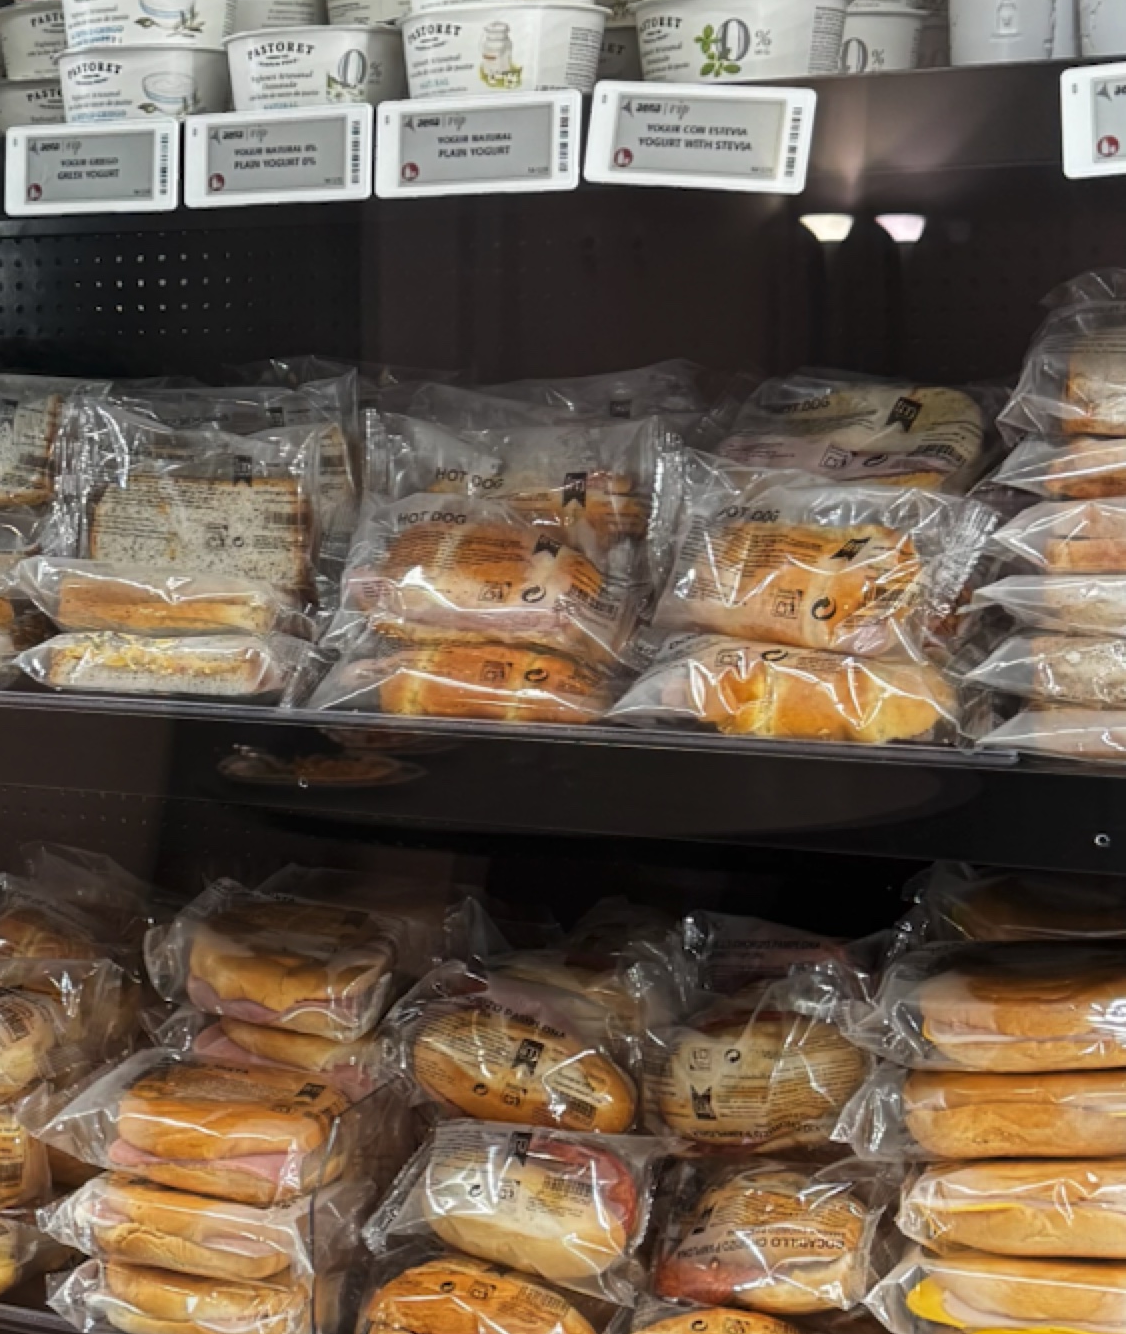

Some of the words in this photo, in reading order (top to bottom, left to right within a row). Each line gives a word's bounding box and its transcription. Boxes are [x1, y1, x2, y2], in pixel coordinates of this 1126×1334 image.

[247, 41, 316, 61] PASTORET
[437, 148, 468, 159] PLAIN
[470, 144, 511, 157] YOGURT
[638, 136, 682, 148] YOGURT
[684, 138, 713, 150] WITH
[715, 140, 753, 152] STEVIA
[435, 468, 468, 482] HOT
[471, 474, 504, 490] DOG
[397, 512, 428, 525] HOT
[431, 511, 467, 525] DOG
